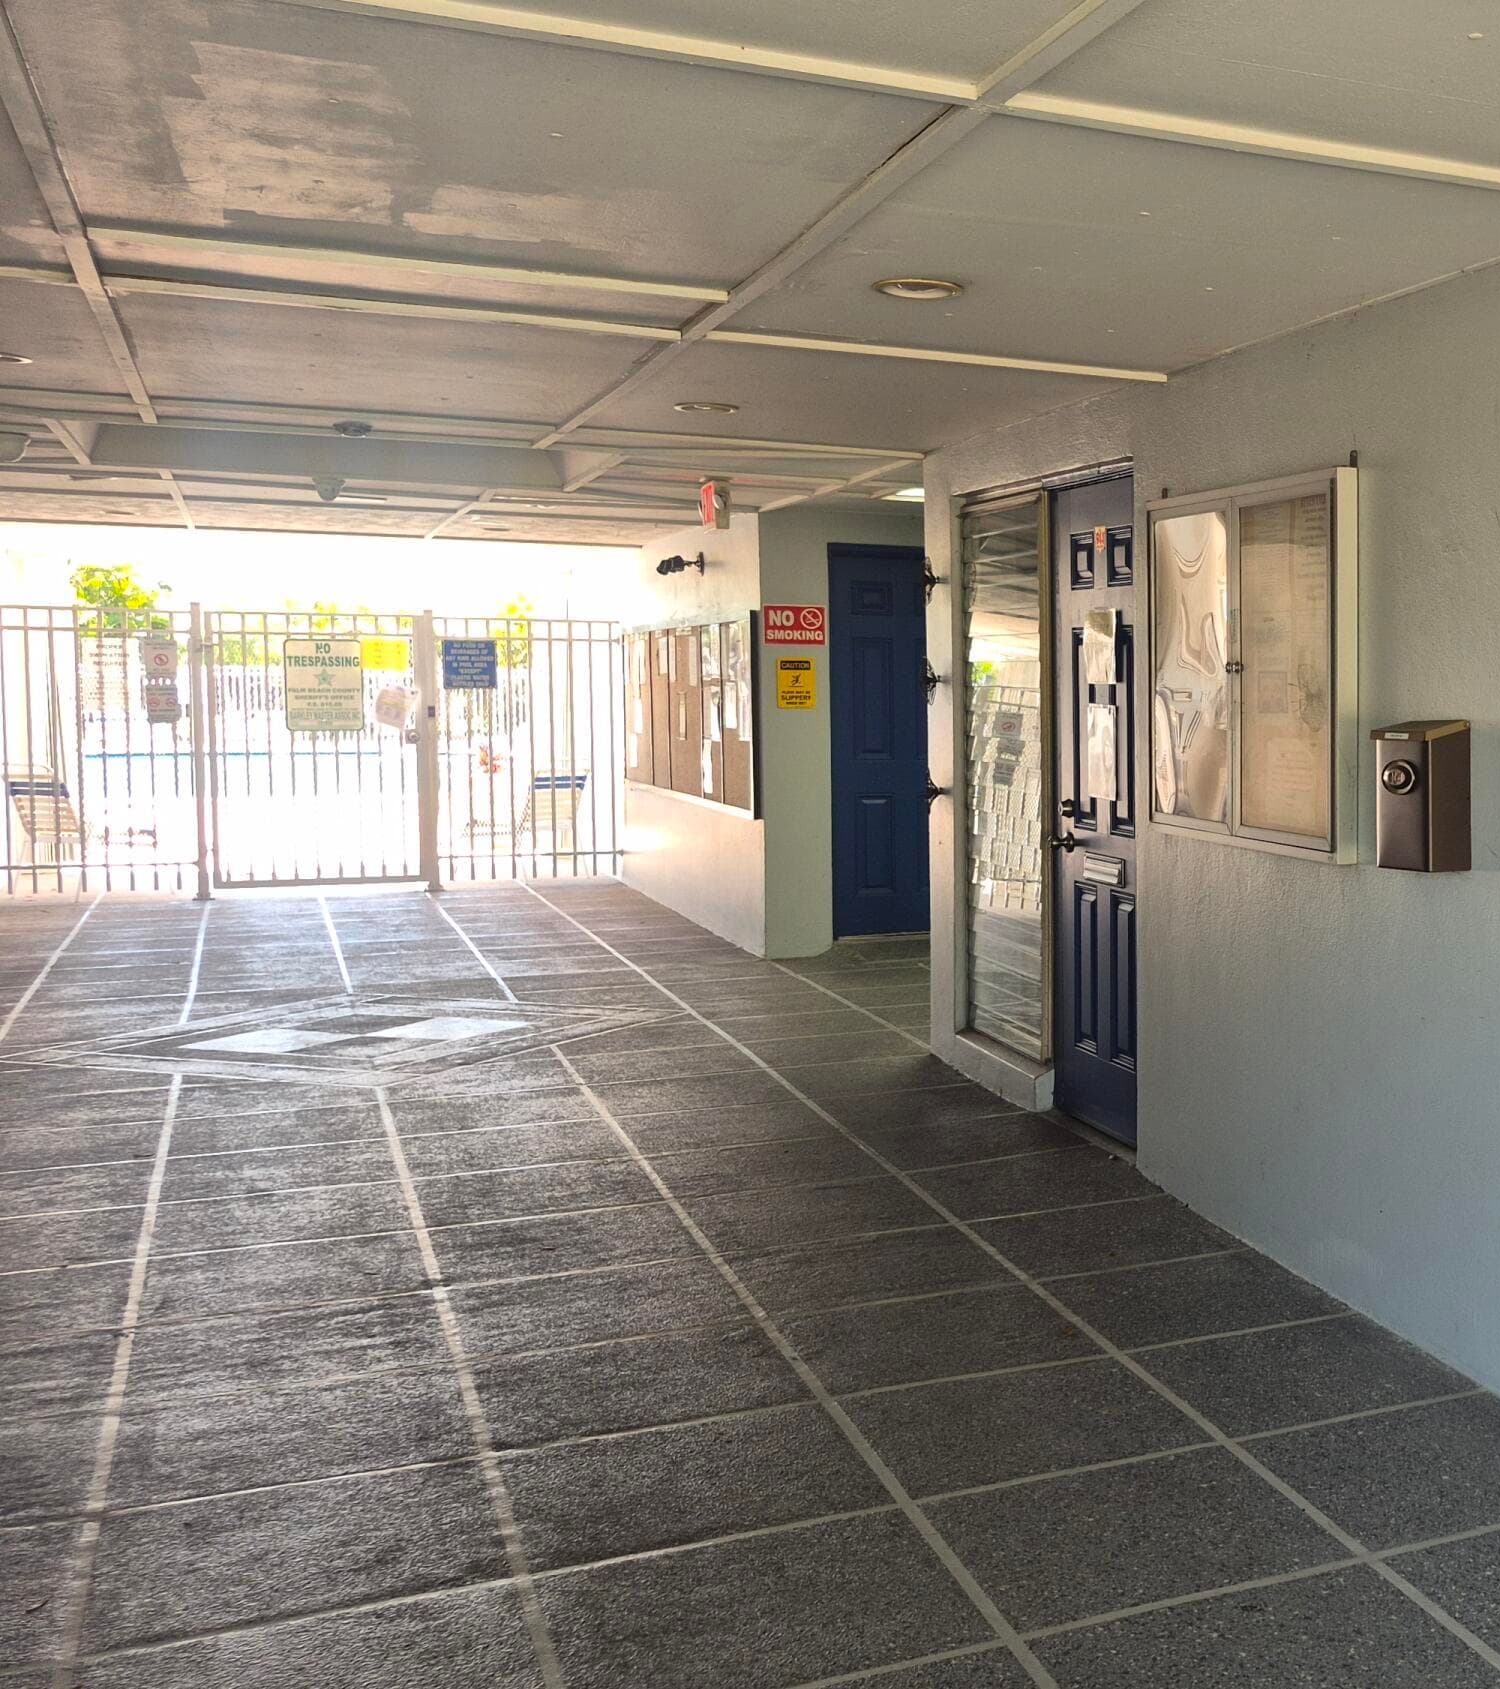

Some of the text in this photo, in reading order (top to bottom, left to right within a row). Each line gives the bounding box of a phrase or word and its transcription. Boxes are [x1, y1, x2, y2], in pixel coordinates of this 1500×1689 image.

[768, 609, 795, 627] NO
[766, 629, 824, 641] SMOKING
[315, 642, 331, 654] NO
[287, 655, 360, 668] TRESPASSING
